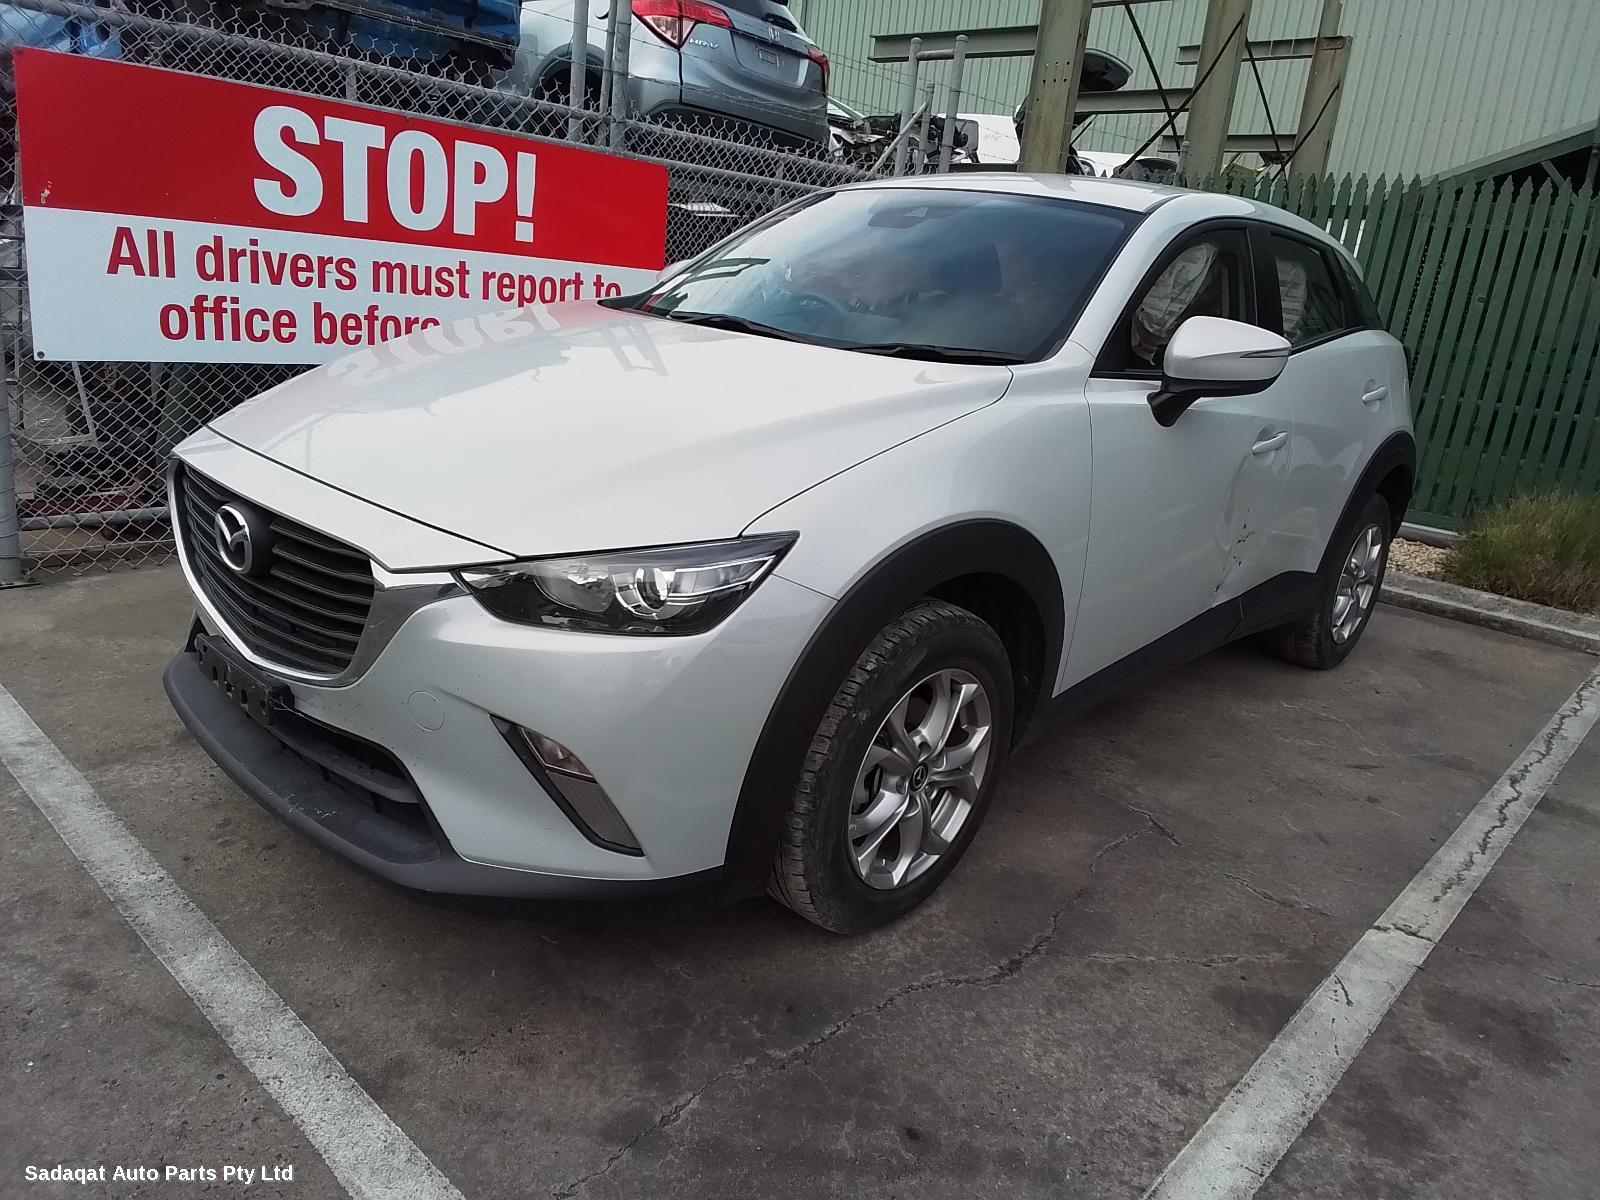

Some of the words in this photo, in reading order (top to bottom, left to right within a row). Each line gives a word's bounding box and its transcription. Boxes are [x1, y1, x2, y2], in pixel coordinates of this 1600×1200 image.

[253, 105, 537, 243] STOP!
[107, 227, 176, 279] All
[196, 235, 358, 292] drivers
[372, 261, 470, 300] must
[481, 271, 584, 308] report
[593, 274, 622, 299] to
[160, 295, 297, 343] office
